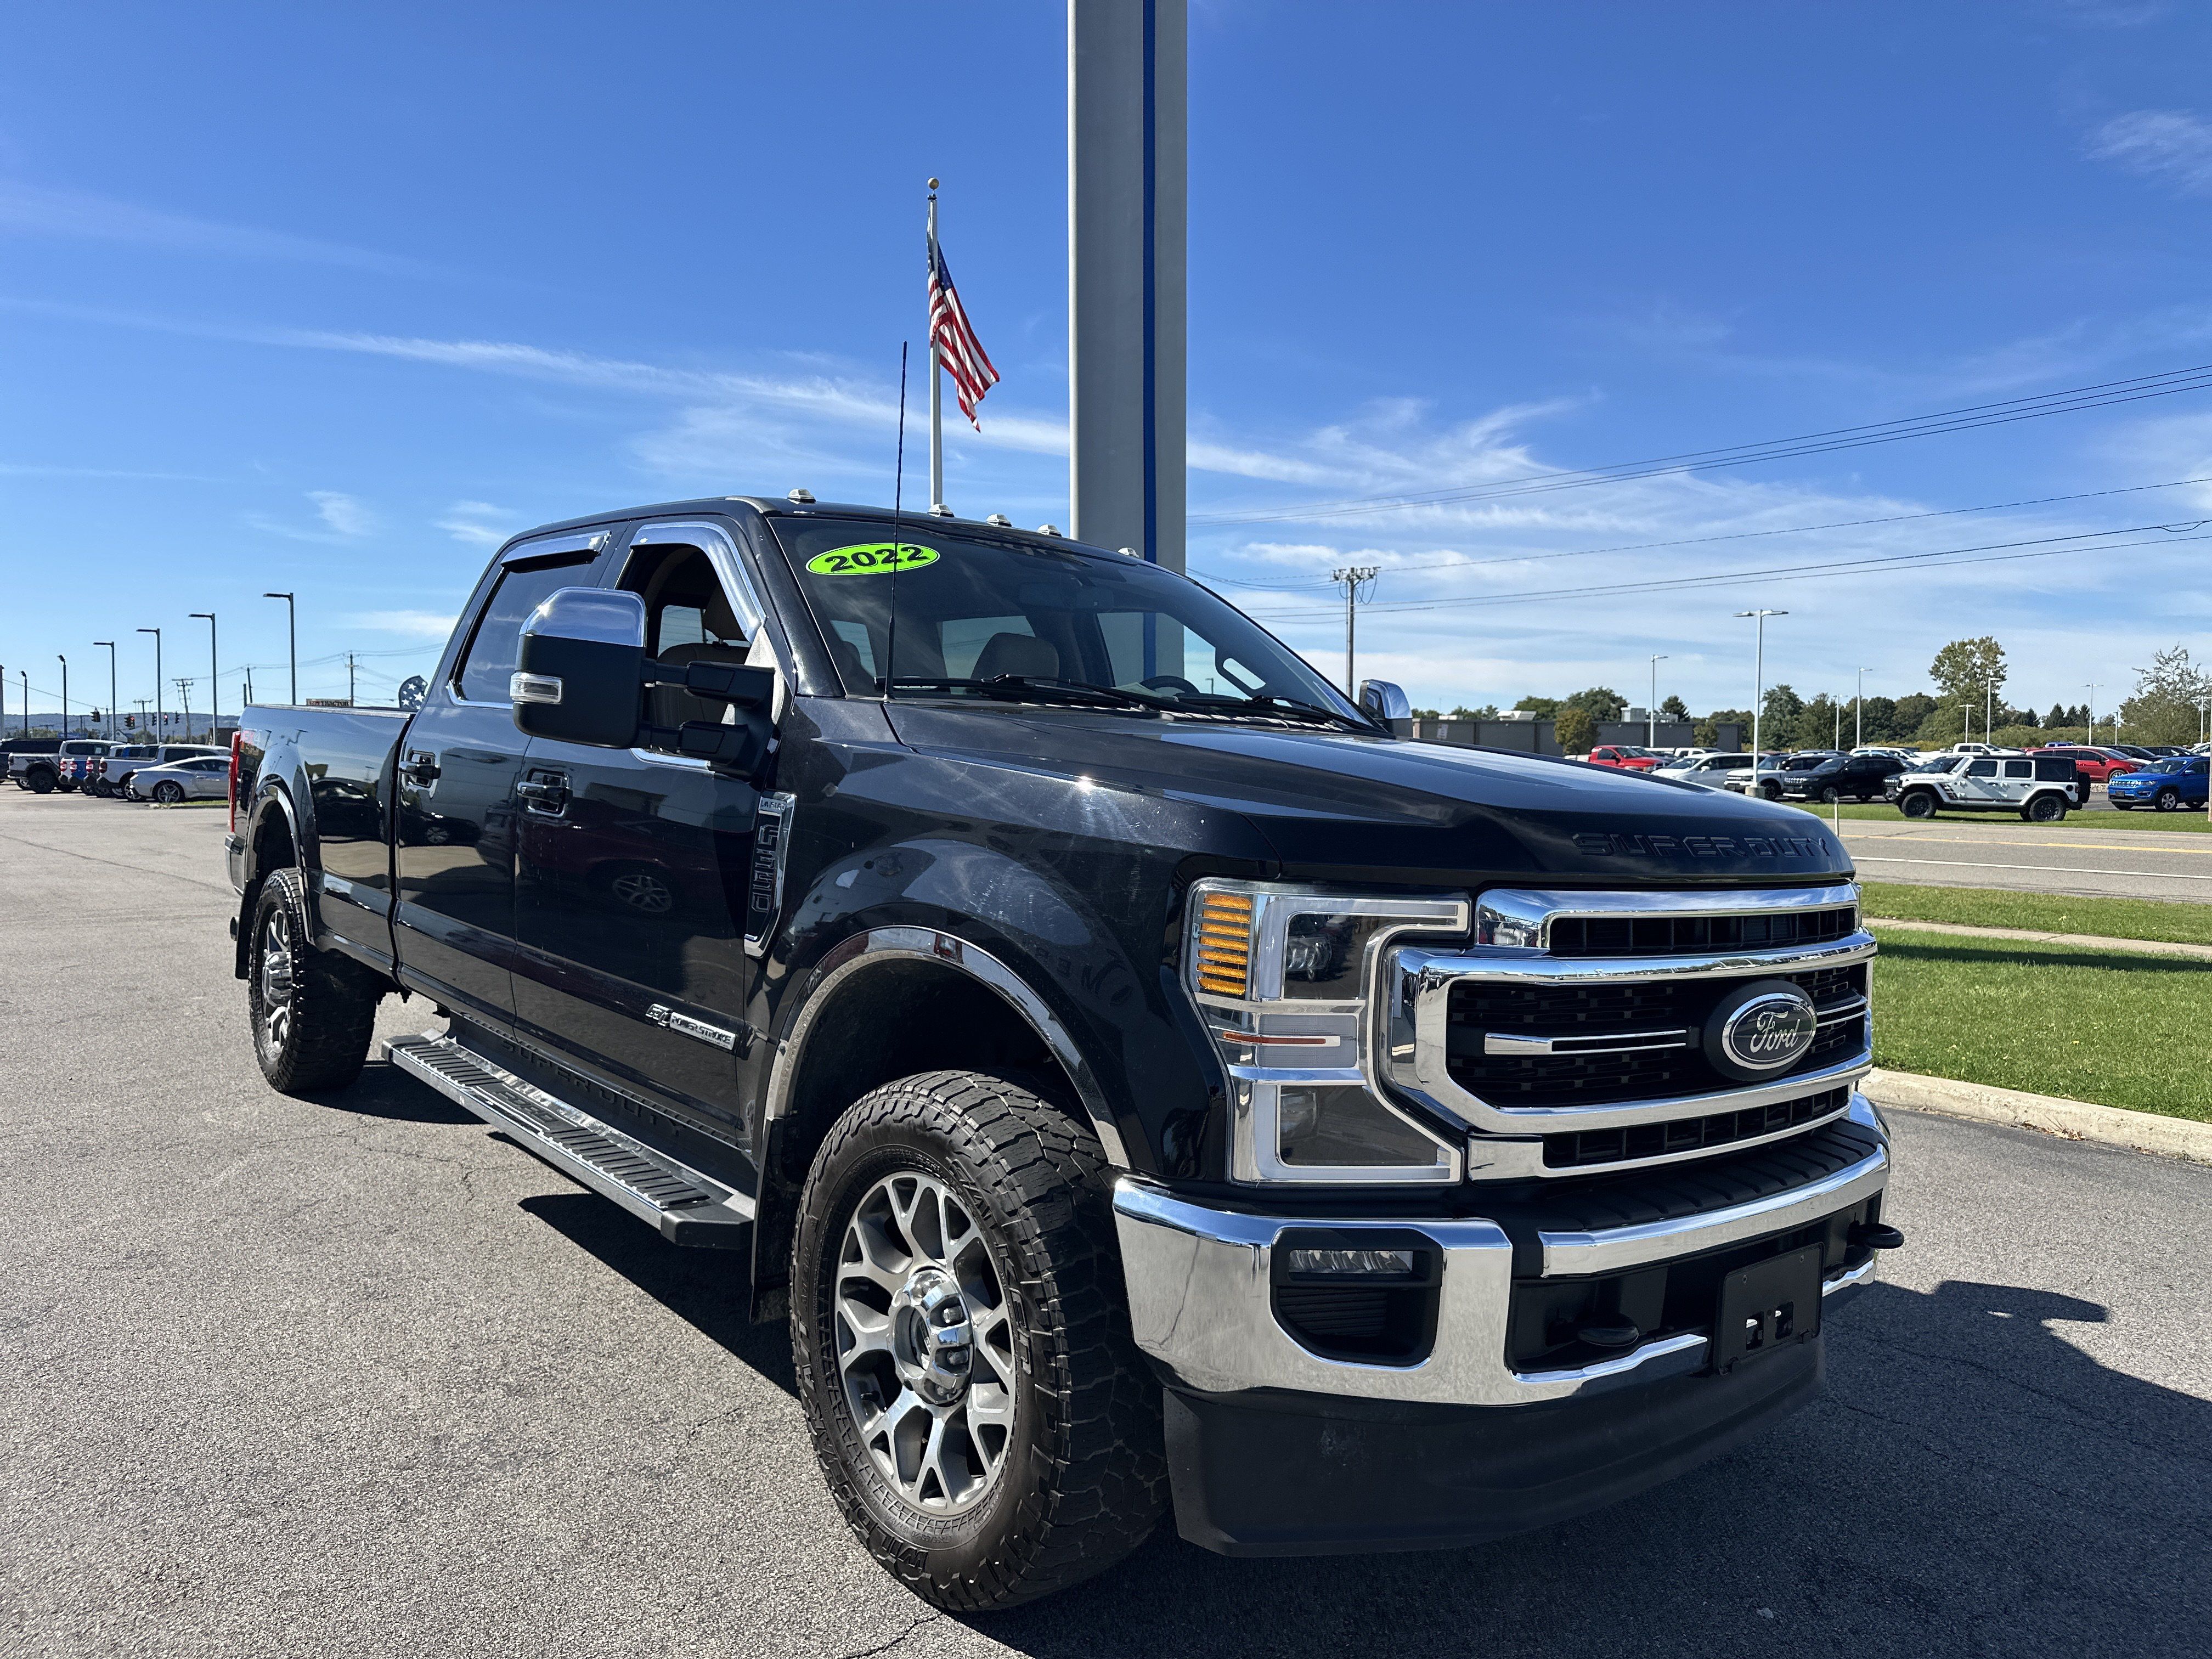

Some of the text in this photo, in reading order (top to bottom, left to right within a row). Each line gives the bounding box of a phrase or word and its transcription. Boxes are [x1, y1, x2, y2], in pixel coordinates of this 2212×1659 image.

[825, 546, 930, 572] 2022
[241, 729, 262, 746] FX4
[1571, 832, 1830, 857] SUPER DUTY
[1750, 1011, 1801, 1053] Ford
